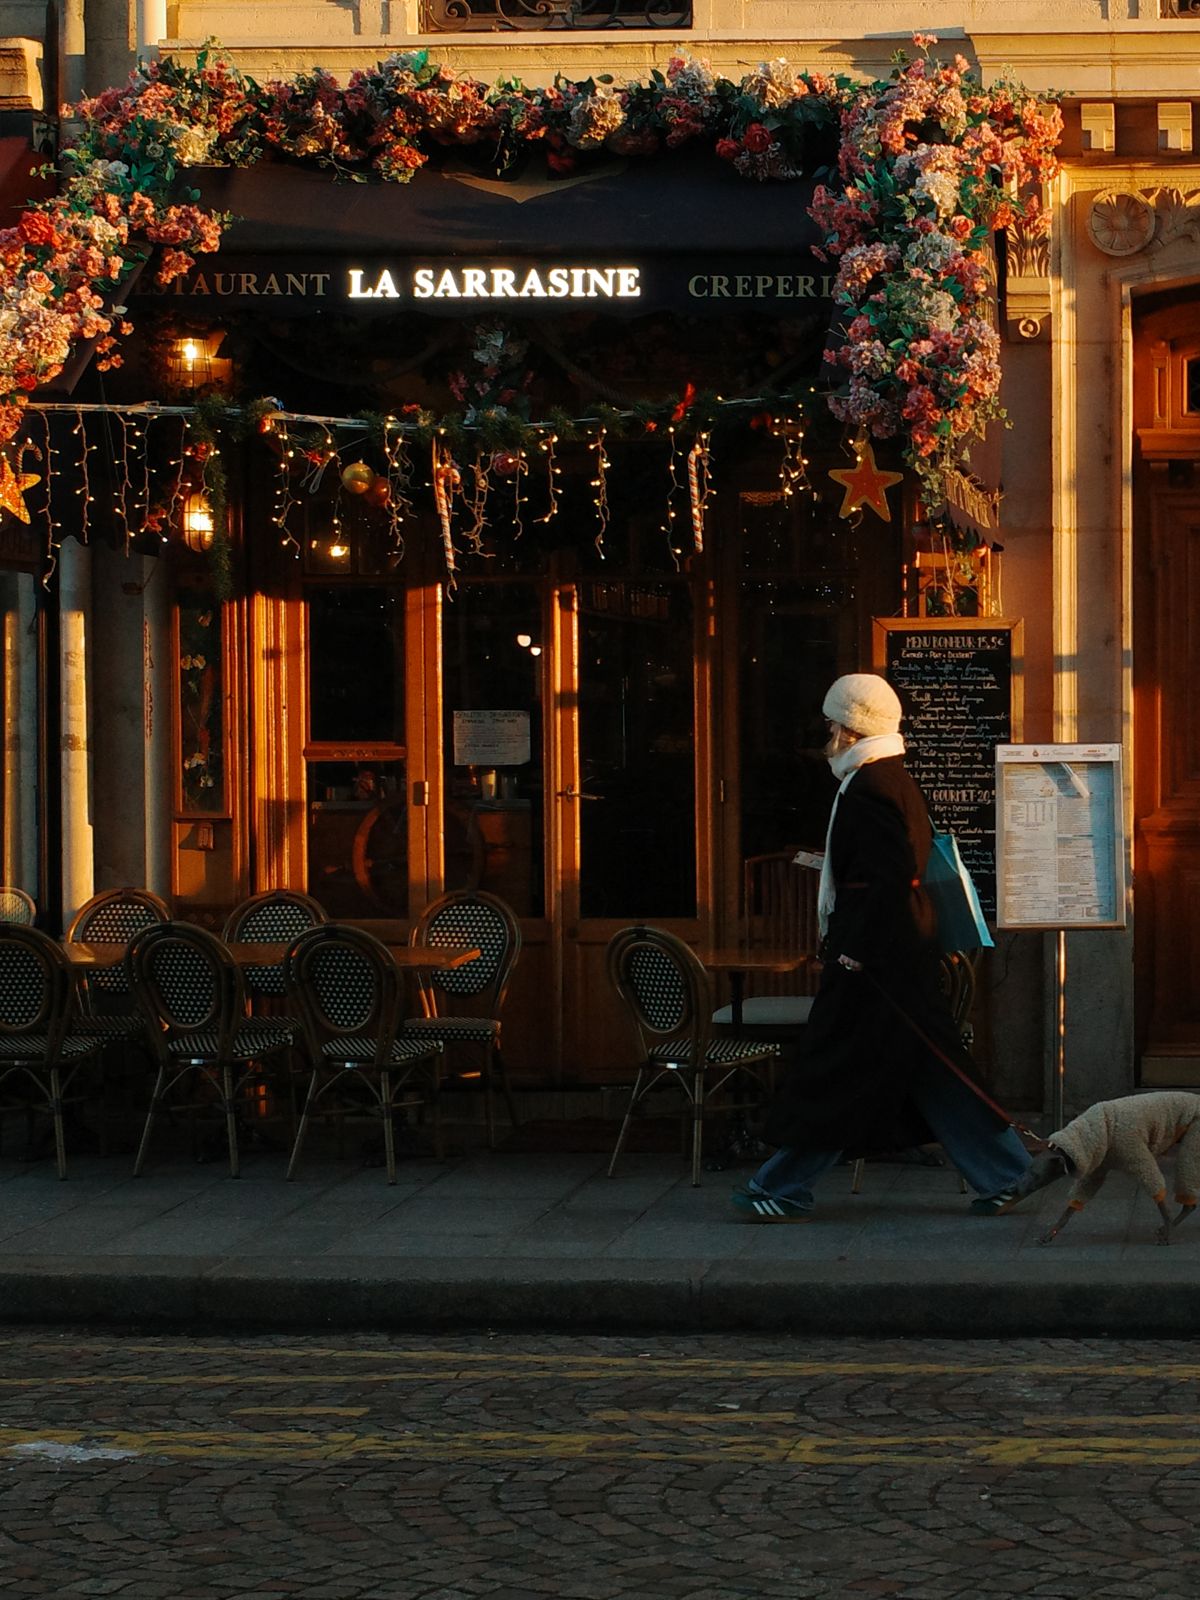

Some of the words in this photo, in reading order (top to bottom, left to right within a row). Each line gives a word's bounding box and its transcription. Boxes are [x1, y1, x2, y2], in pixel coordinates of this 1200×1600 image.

[347, 268, 400, 299] LA
[413, 267, 642, 300] SARRASINE
[932, 789, 974, 802] GOURMET
